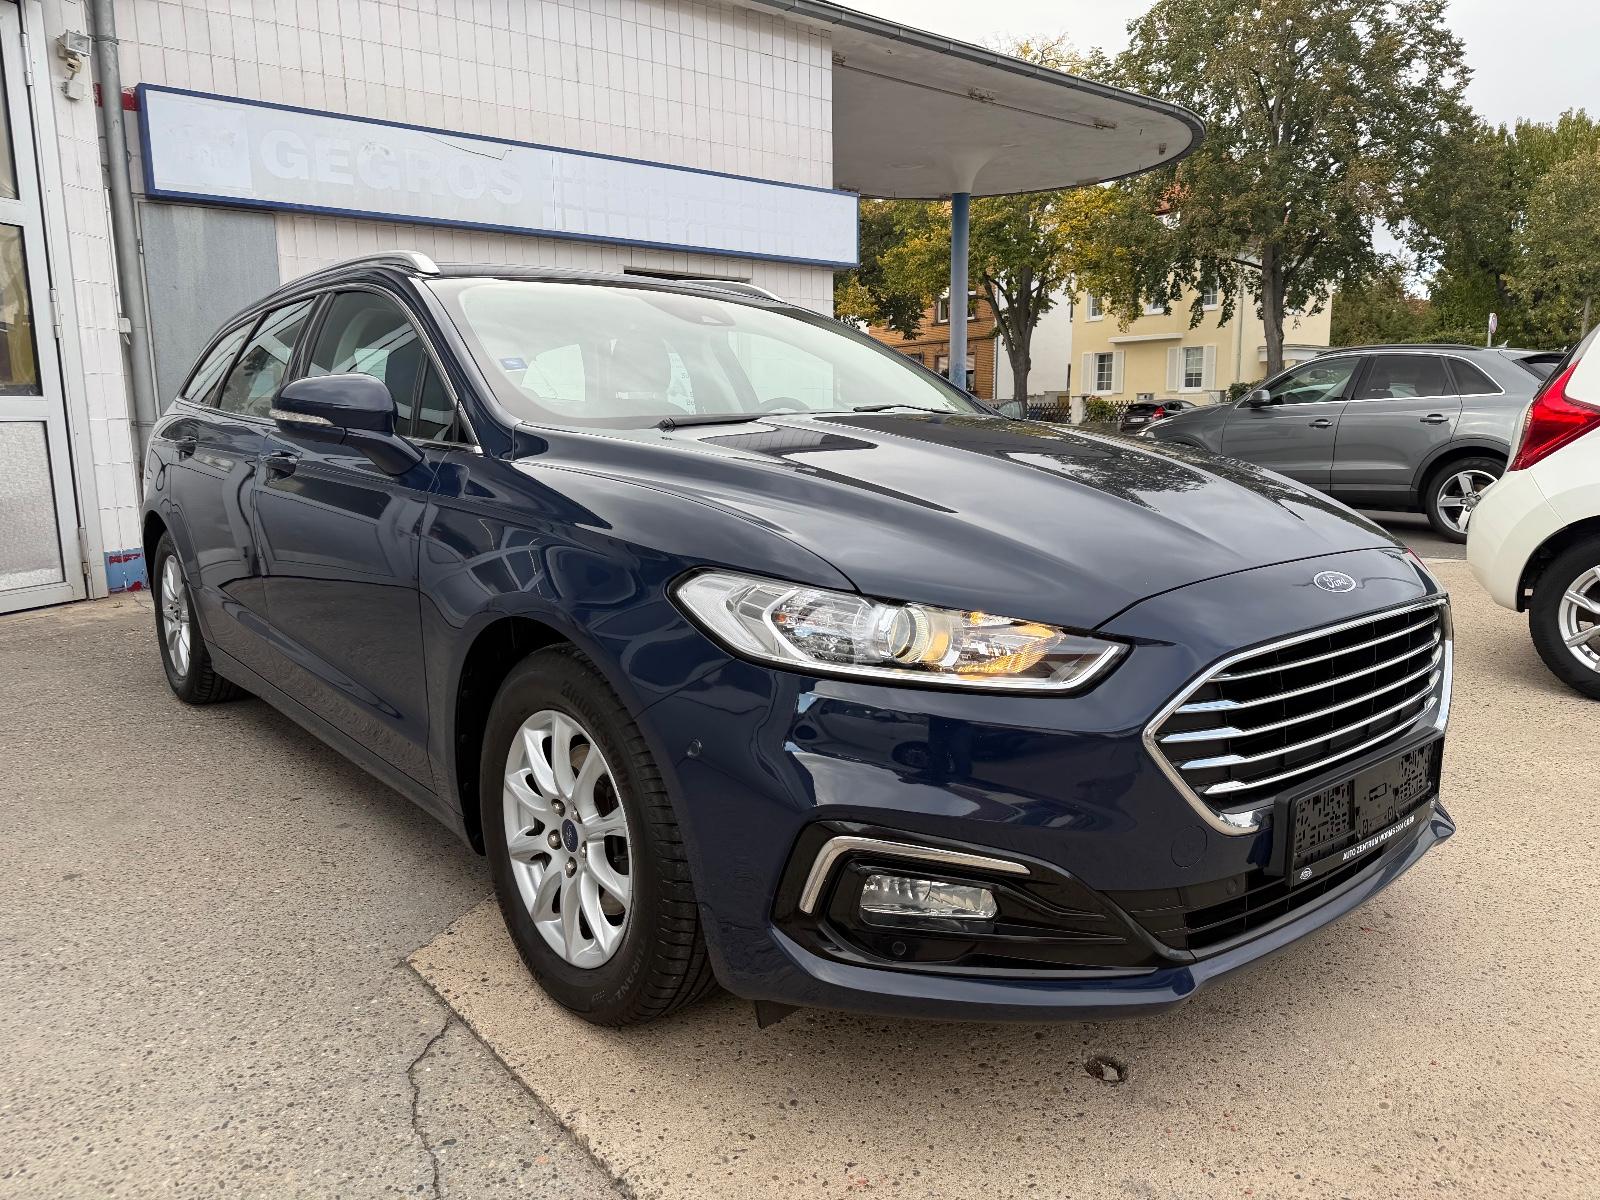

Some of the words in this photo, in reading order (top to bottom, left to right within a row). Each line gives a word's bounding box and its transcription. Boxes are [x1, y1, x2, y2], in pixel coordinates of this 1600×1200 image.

[1343, 848, 1356, 861] AUTO
[1357, 837, 1378, 854] ZENTRUM
[1379, 828, 1395, 842] WORMS
